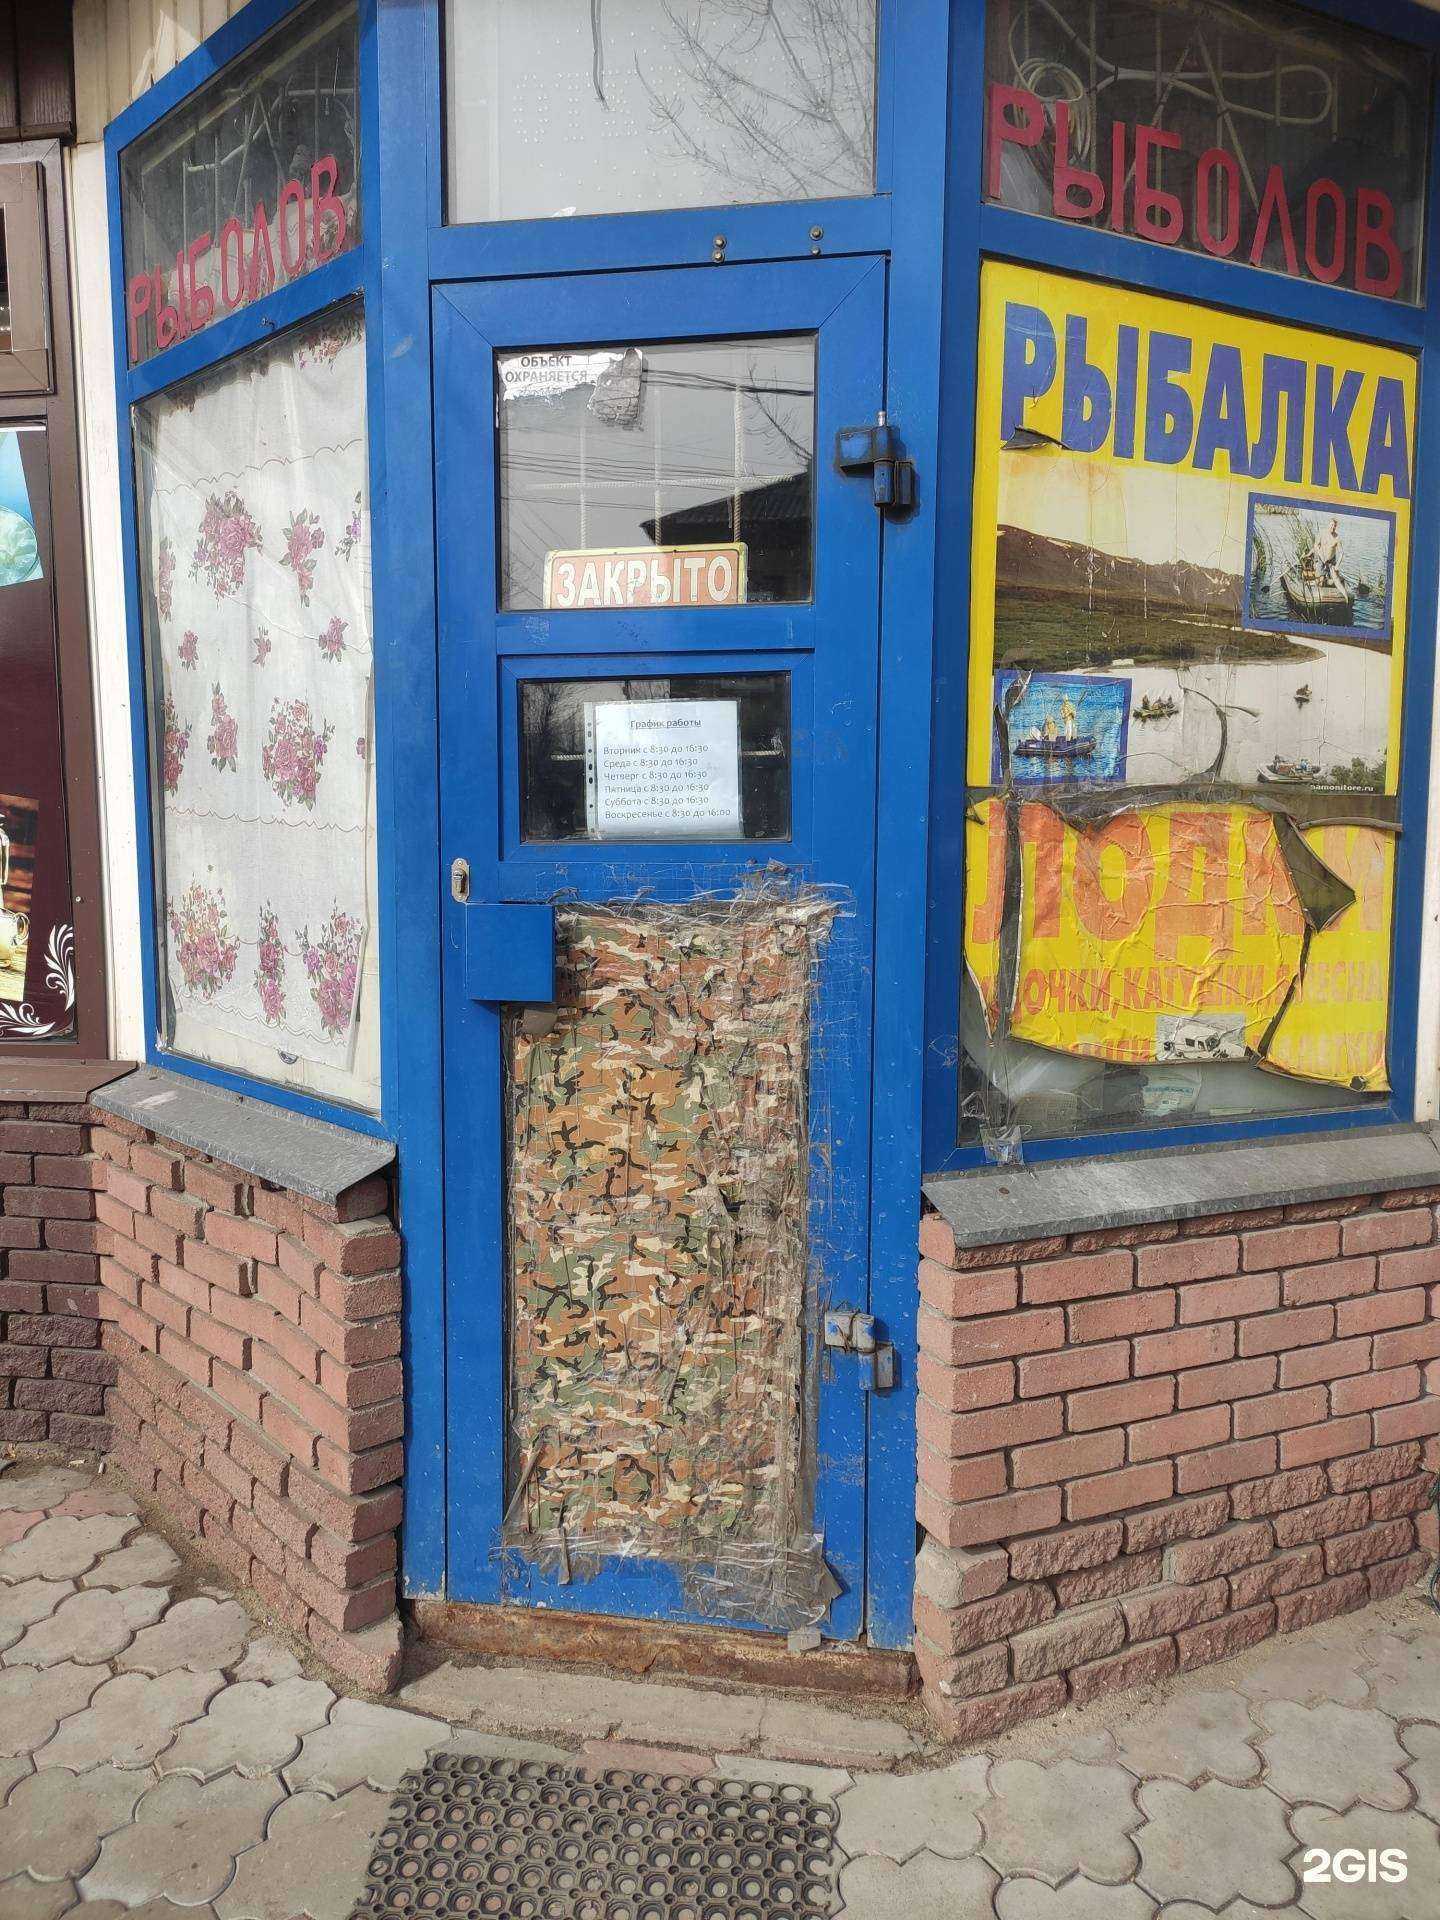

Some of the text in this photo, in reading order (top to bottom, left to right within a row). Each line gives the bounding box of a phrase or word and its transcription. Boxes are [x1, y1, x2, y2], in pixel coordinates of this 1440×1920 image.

[986, 82, 1405, 299] РЫБОЛОВ
[128, 154, 347, 363] РЫБОЛОВ
[520, 355, 573, 368] ОБЪЕКТ
[504, 370, 588, 383] ОХРАНЯЕТСЯ
[1001, 301, 1413, 498] РЫБАЛКА
[556, 554, 734, 608] ЗАКРЫТО
[630, 718, 702, 730] График работы
[603, 747, 641, 756] Вторник
[650, 745, 669, 755] 8:30
[671, 746, 683, 755] до
[685, 744, 709, 754] 16:30
[603, 760, 631, 769] Среда
[640, 758, 659, 768] 8:30
[661, 759, 673, 767] до
[675, 757, 698, 766] 16:30
[604, 772, 640, 781] Четверг
[649, 771, 668, 781] 8:30
[670, 772, 682, 780] до
[684, 770, 708, 779] 16:30
[604, 785, 642, 795] Пятница
[650, 784, 670, 794] 8:30
[672, 785, 684, 793] до
[686, 783, 710, 792] 16:30
[604, 798, 642, 808] Суббота
[651, 796, 670, 807] 8:30
[672, 797, 684, 806] до
[686, 796, 709, 805] 16:30
[605, 811, 663, 820] Воскресенье
[671, 809, 691, 819] 8:30
[693, 810, 705, 818] до
[708, 808, 731, 817] 16:00
